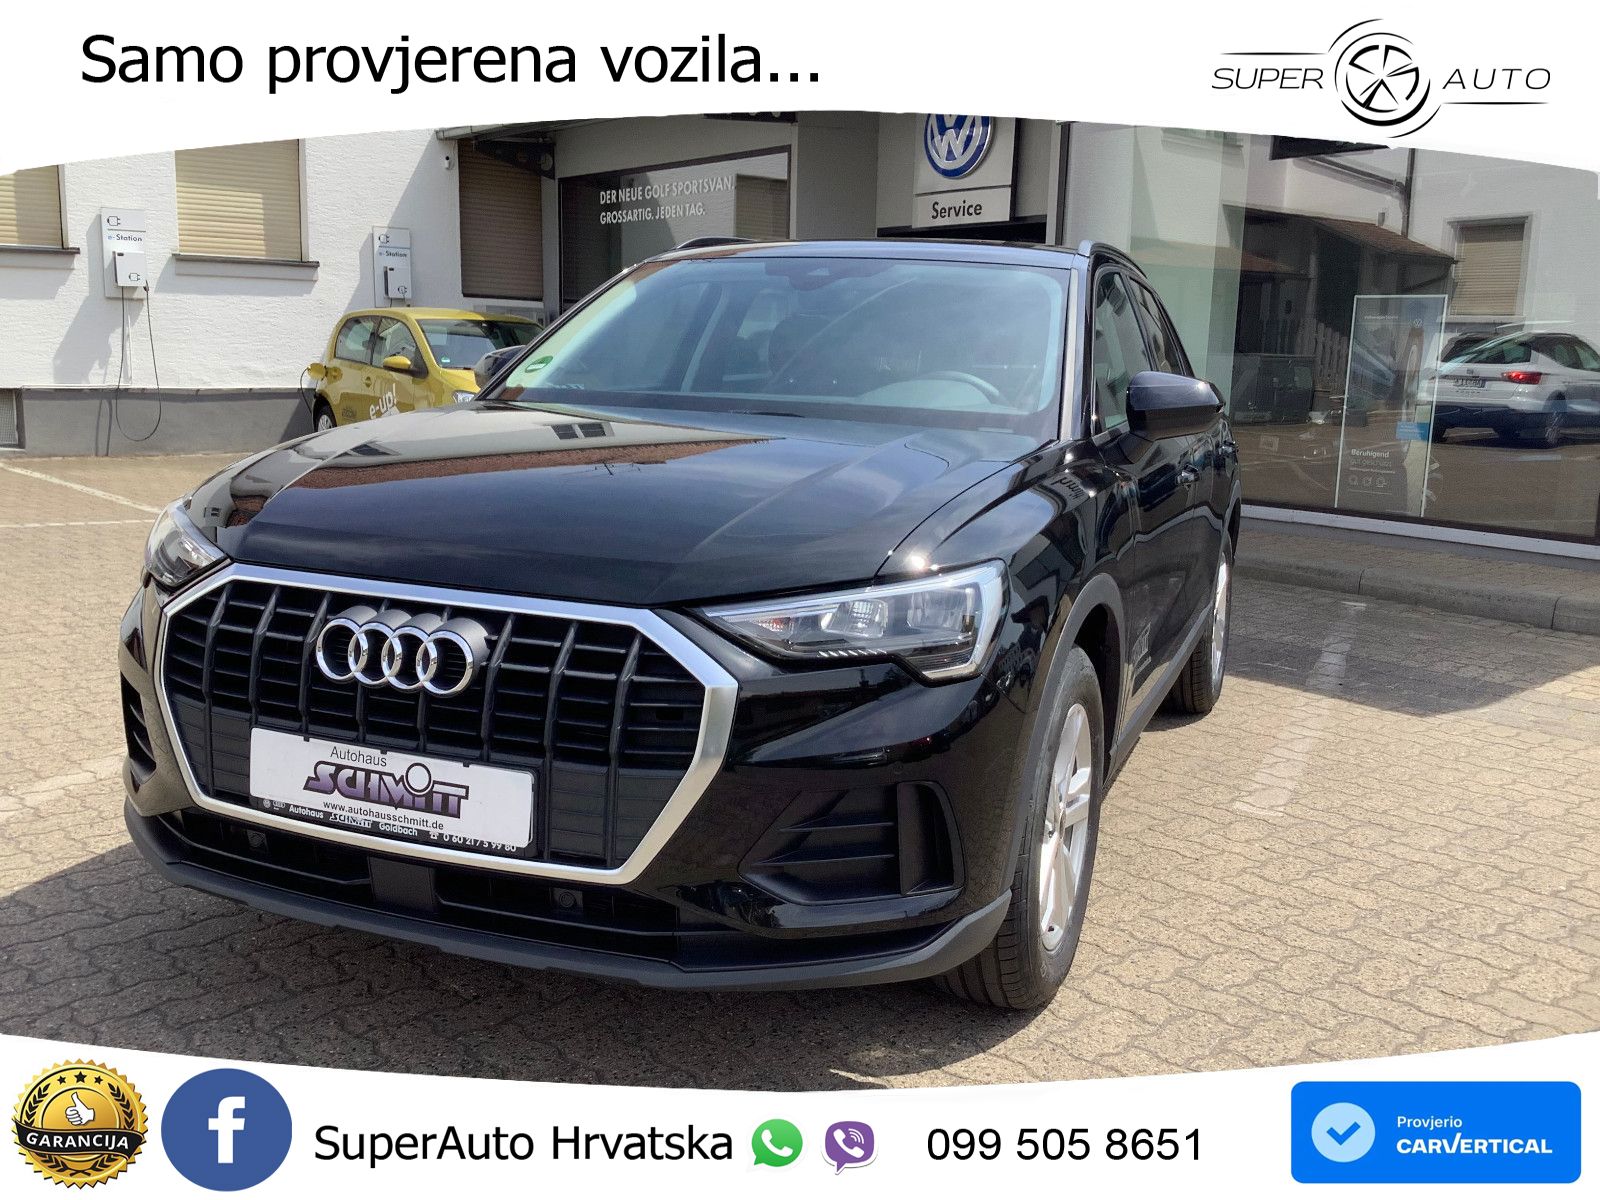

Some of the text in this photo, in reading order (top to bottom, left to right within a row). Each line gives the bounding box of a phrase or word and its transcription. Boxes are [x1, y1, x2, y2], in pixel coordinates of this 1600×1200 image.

[600, 175, 735, 205] DER NEUE GOLF SPORTSVAN.
[600, 202, 706, 224] GROSSARTIG. JEDEN TAG.
[931, 199, 983, 220] Service
[369, 382, 397, 420] e-up!
[330, 746, 388, 768] Autohaus
[303, 761, 470, 819] SCHMITT
[289, 804, 324, 819] Autohaus
[379, 822, 418, 837] Goldbach
[323, 800, 444, 831] www.autohausschmitt.de
